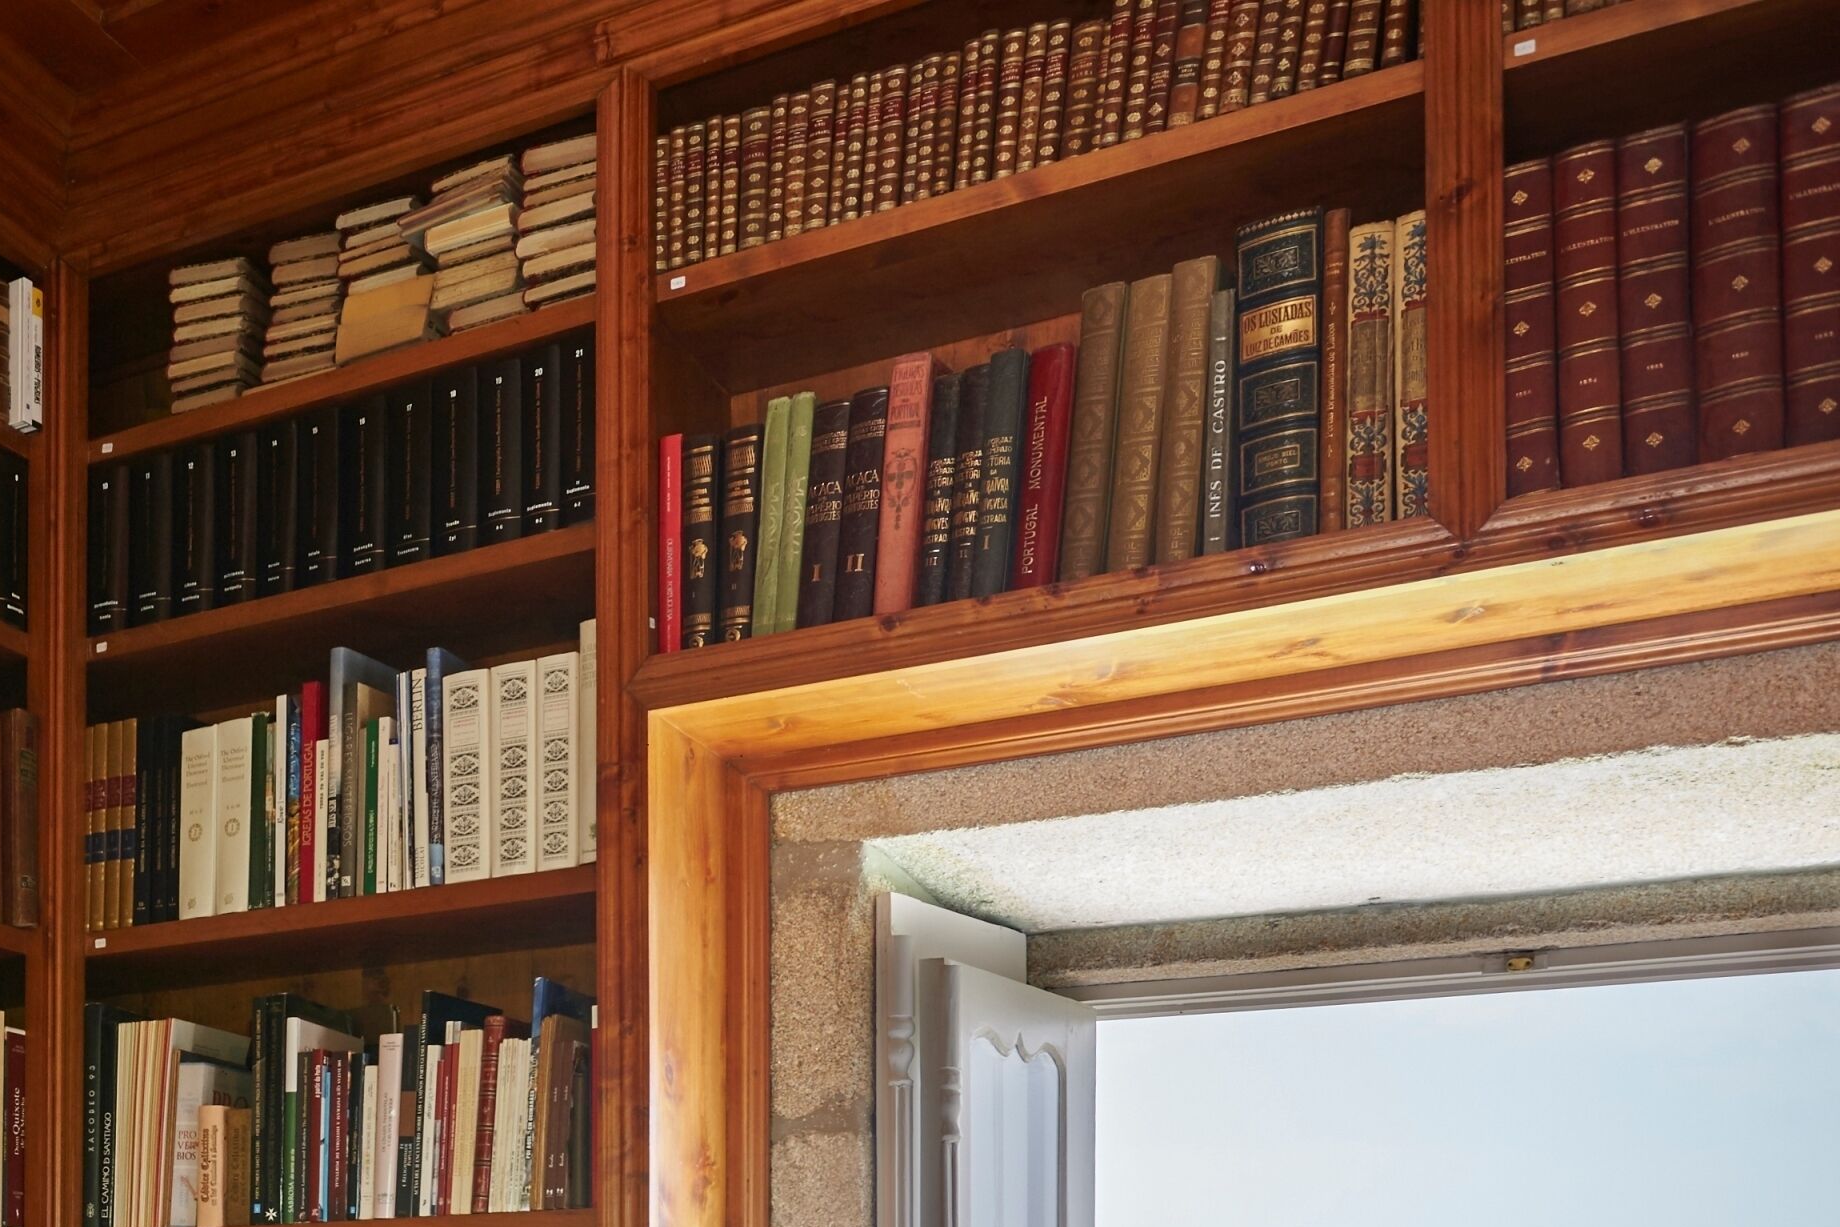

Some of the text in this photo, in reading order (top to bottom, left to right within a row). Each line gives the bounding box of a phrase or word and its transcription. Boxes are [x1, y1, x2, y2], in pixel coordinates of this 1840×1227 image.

[1243, 302, 1313, 334] OS LUSIADAS
[1269, 324, 1283, 335] DE
[575, 348, 584, 358] 21
[1245, 328, 1310, 357] LUIZ DE CAMÕES
[534, 367, 543, 378] 20
[1208, 360, 1226, 519] INÊS DE CASTRO
[1021, 395, 1048, 575] PORTUGAL MONUMENTAL
[411, 678, 423, 732] BERLIN
[301, 739, 313, 846] IGREJAS DE PORTUGAL
[342, 711, 354, 848] LUGARES MISTERIOSOS
[12, 1086, 21, 1156] Dom Quixote
[102, 1112, 111, 1155] SANTIAGO
[178, 1130, 197, 1140] PRO
[176, 1151, 197, 1160] BIOS
[101, 1166, 110, 1204] CAMINO
[287, 1180, 295, 1213] SABROSA
[101, 1205, 109, 1219] EL
